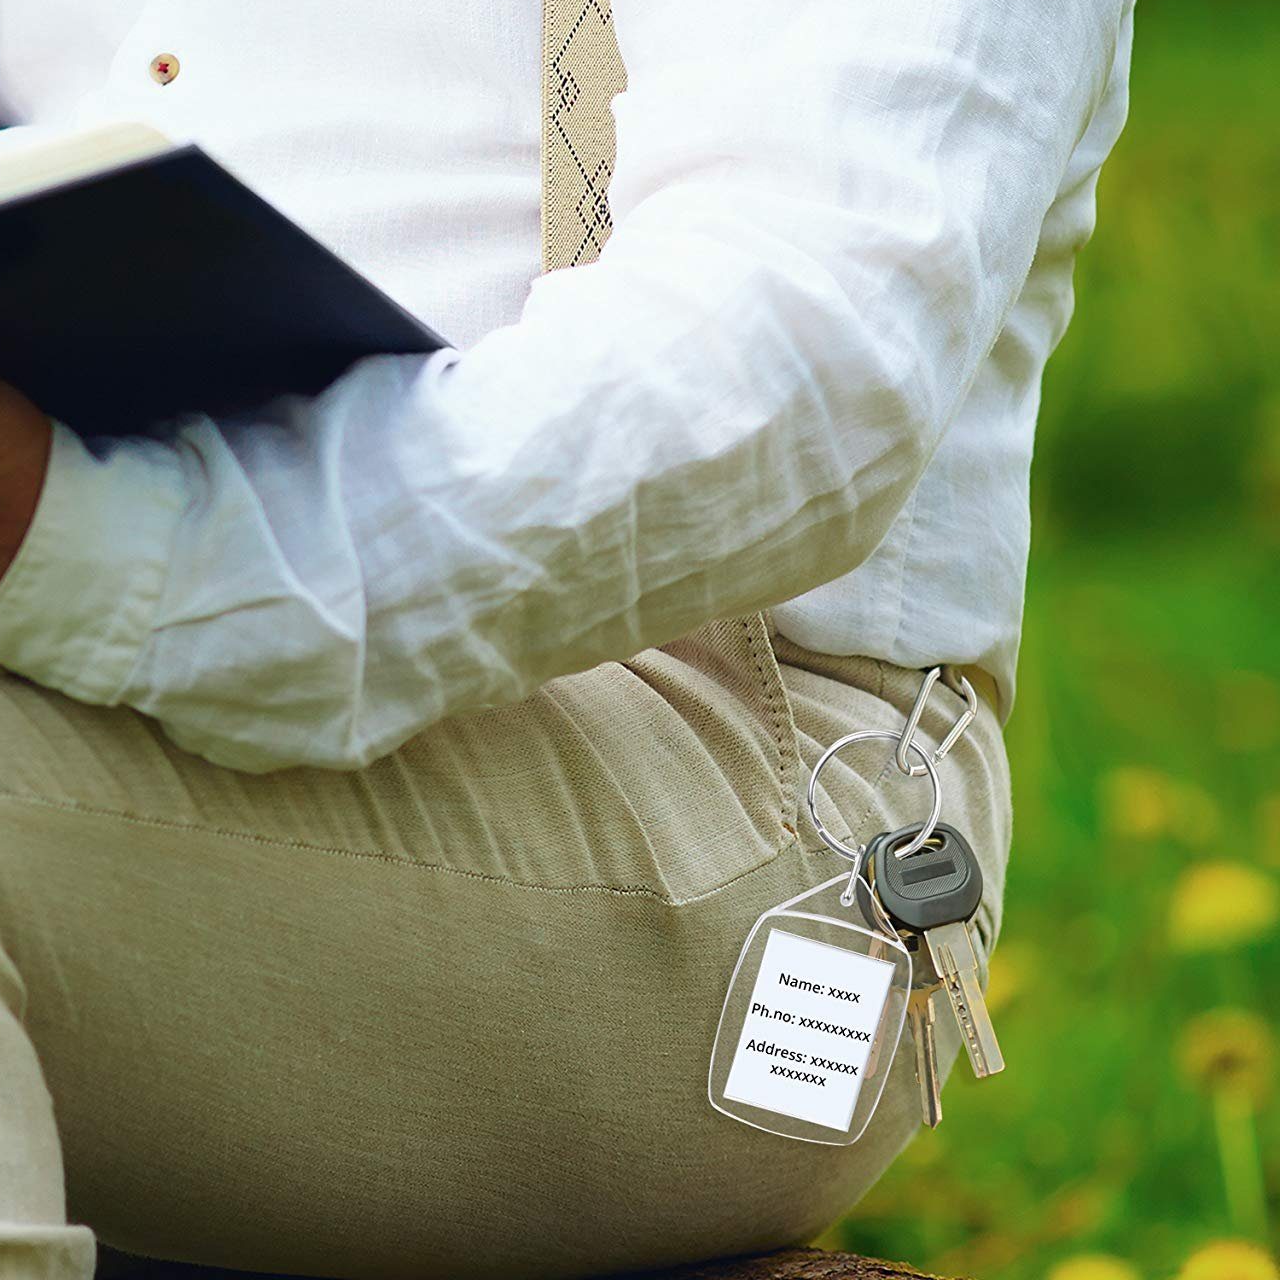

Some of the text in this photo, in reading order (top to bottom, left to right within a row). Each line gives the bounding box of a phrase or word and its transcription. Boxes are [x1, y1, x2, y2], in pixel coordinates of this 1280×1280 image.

[778, 972, 861, 1004] Name: xxxx
[751, 1002, 872, 1043] Ph.no: xxxxxxxxx
[745, 1038, 859, 1076] Address: xxxxxx
[769, 1064, 827, 1087] xxxxxxx
